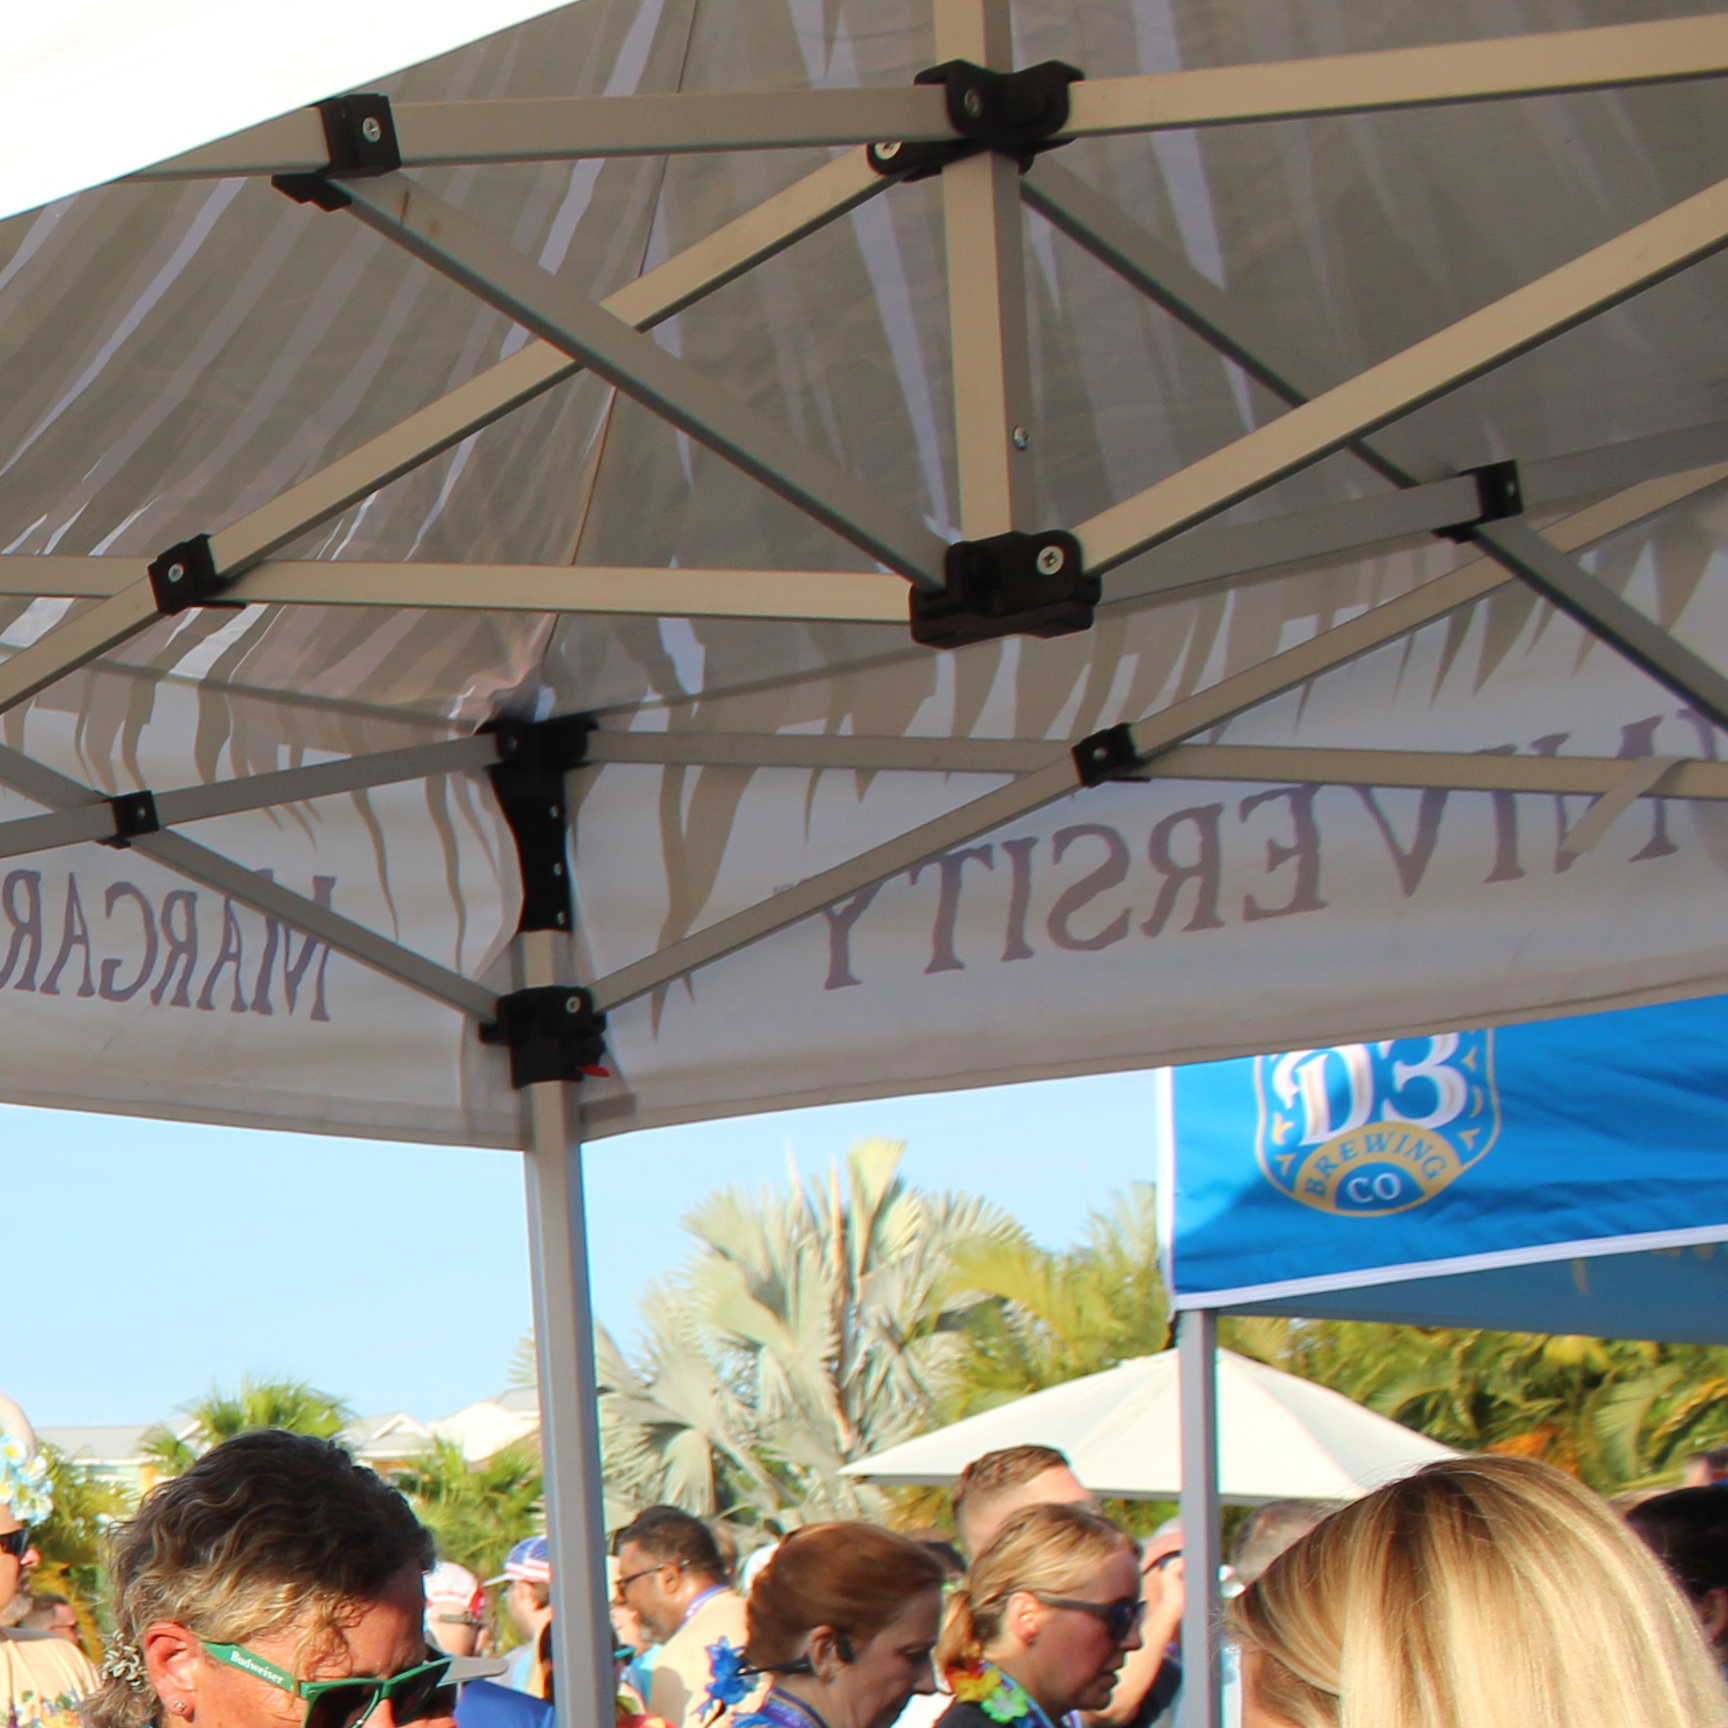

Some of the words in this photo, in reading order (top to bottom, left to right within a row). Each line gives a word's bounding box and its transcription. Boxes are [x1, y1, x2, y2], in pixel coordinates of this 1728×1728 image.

[1306, 1131, 1448, 1199] BREWING
[1348, 1172, 1402, 1203] CO
[230, 1650, 284, 1684] Budweiser
